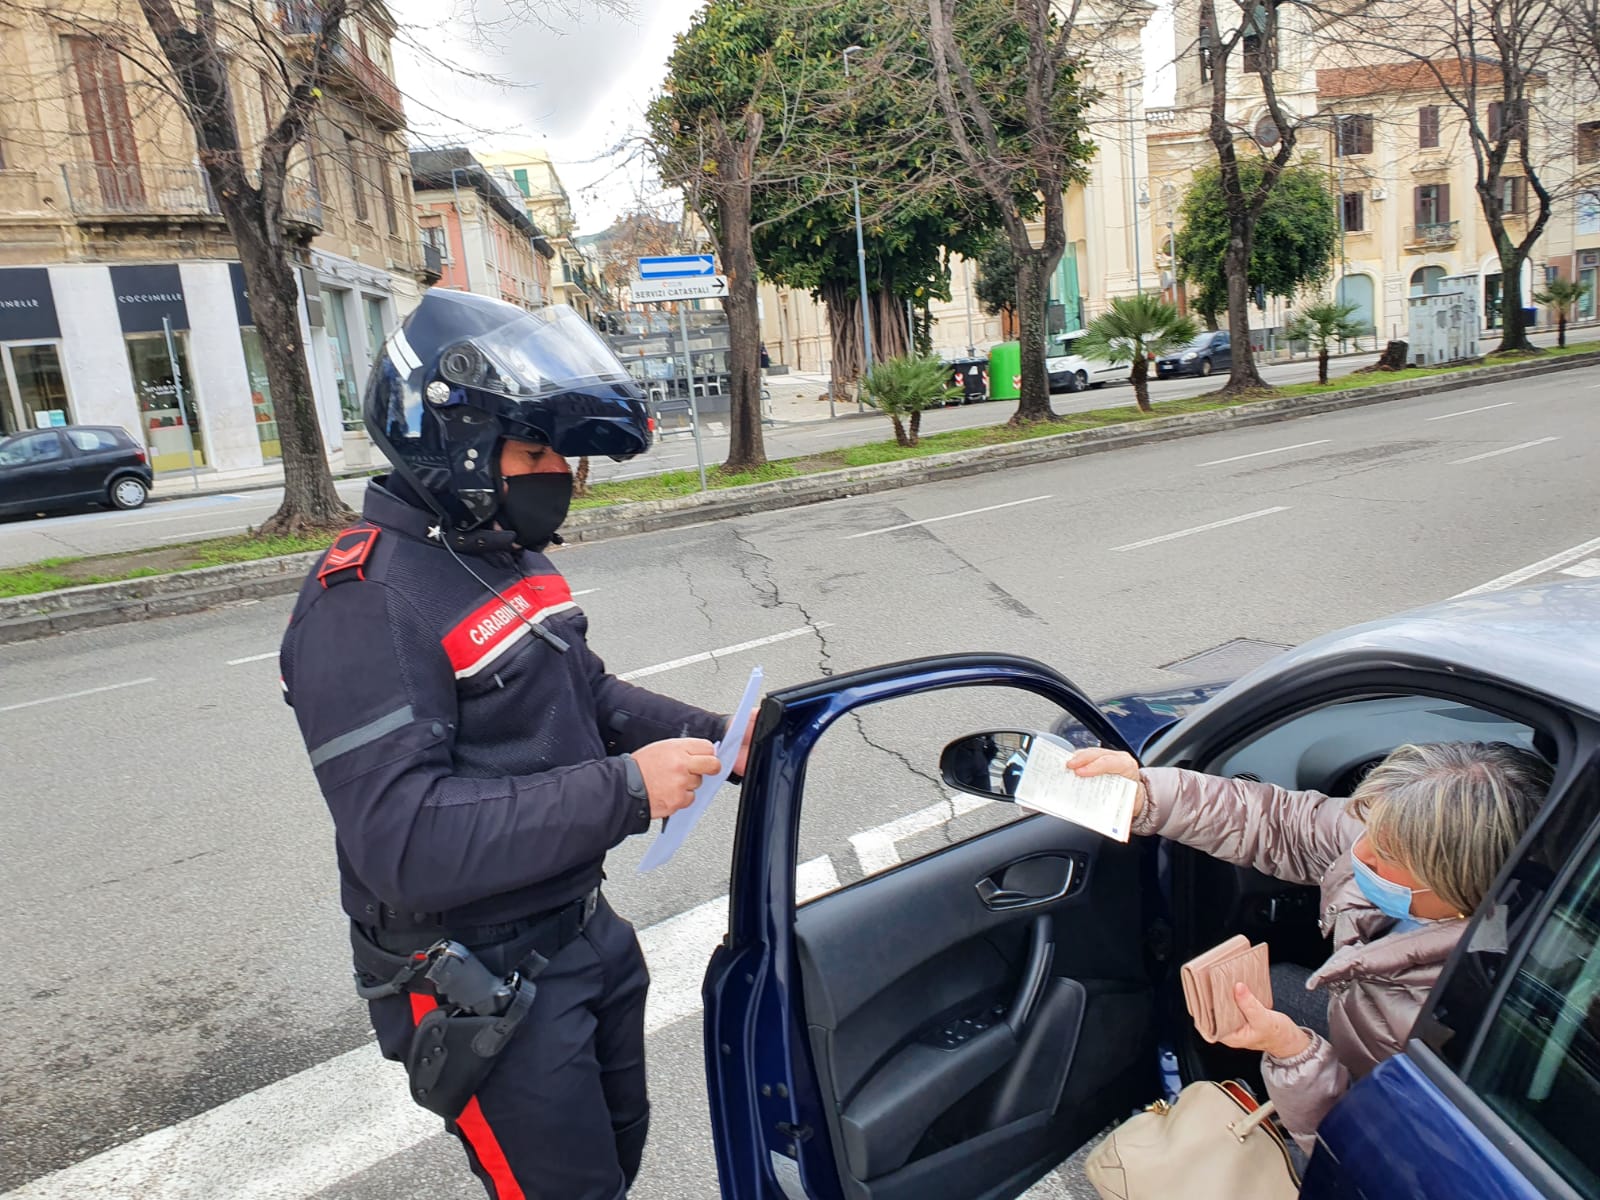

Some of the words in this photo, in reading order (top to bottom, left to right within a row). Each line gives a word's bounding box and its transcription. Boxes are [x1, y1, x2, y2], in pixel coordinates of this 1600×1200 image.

[118, 293, 183, 303] COCCINELLE
[635, 290, 666, 299] SERVIZI
[668, 286, 709, 297] CATASTALI
[469, 594, 530, 645] CARABINERI
